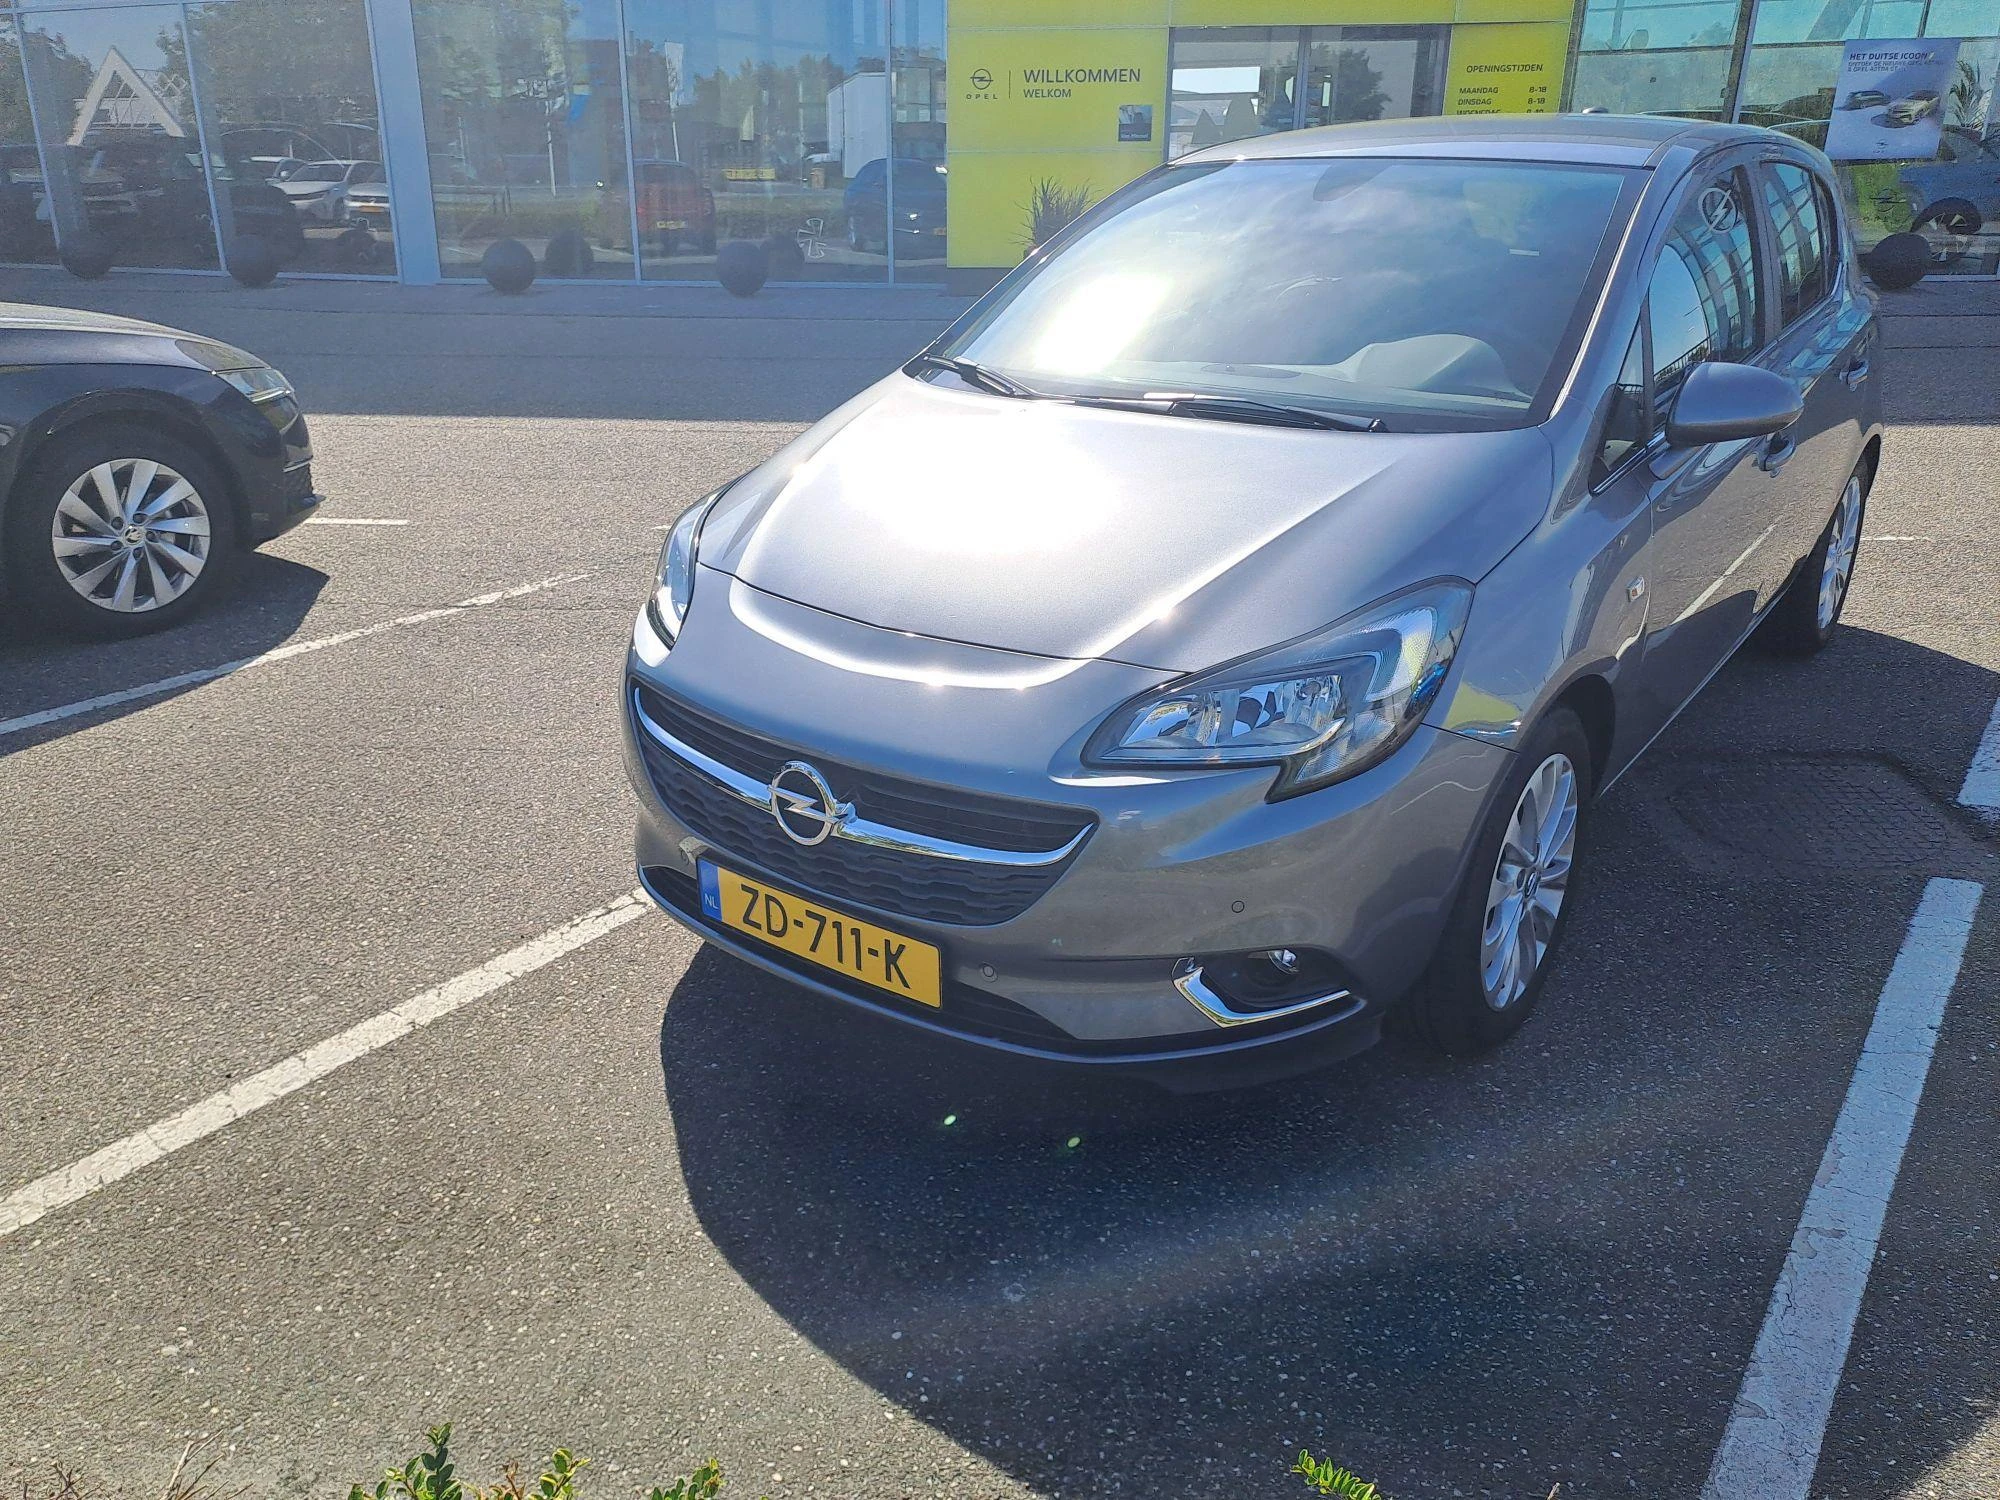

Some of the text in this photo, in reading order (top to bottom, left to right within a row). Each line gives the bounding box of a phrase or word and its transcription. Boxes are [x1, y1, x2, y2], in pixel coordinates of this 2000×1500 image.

[1466, 64, 1544, 73] OPENINGSTIJDEN
[1023, 68, 1141, 83] WILLKOMMEN
[1023, 88, 1072, 99] WELKOM
[1457, 97, 1546, 106] DINSDAG 8-18
[704, 893, 719, 911] NL
[740, 883, 911, 989] ZD-711-K
